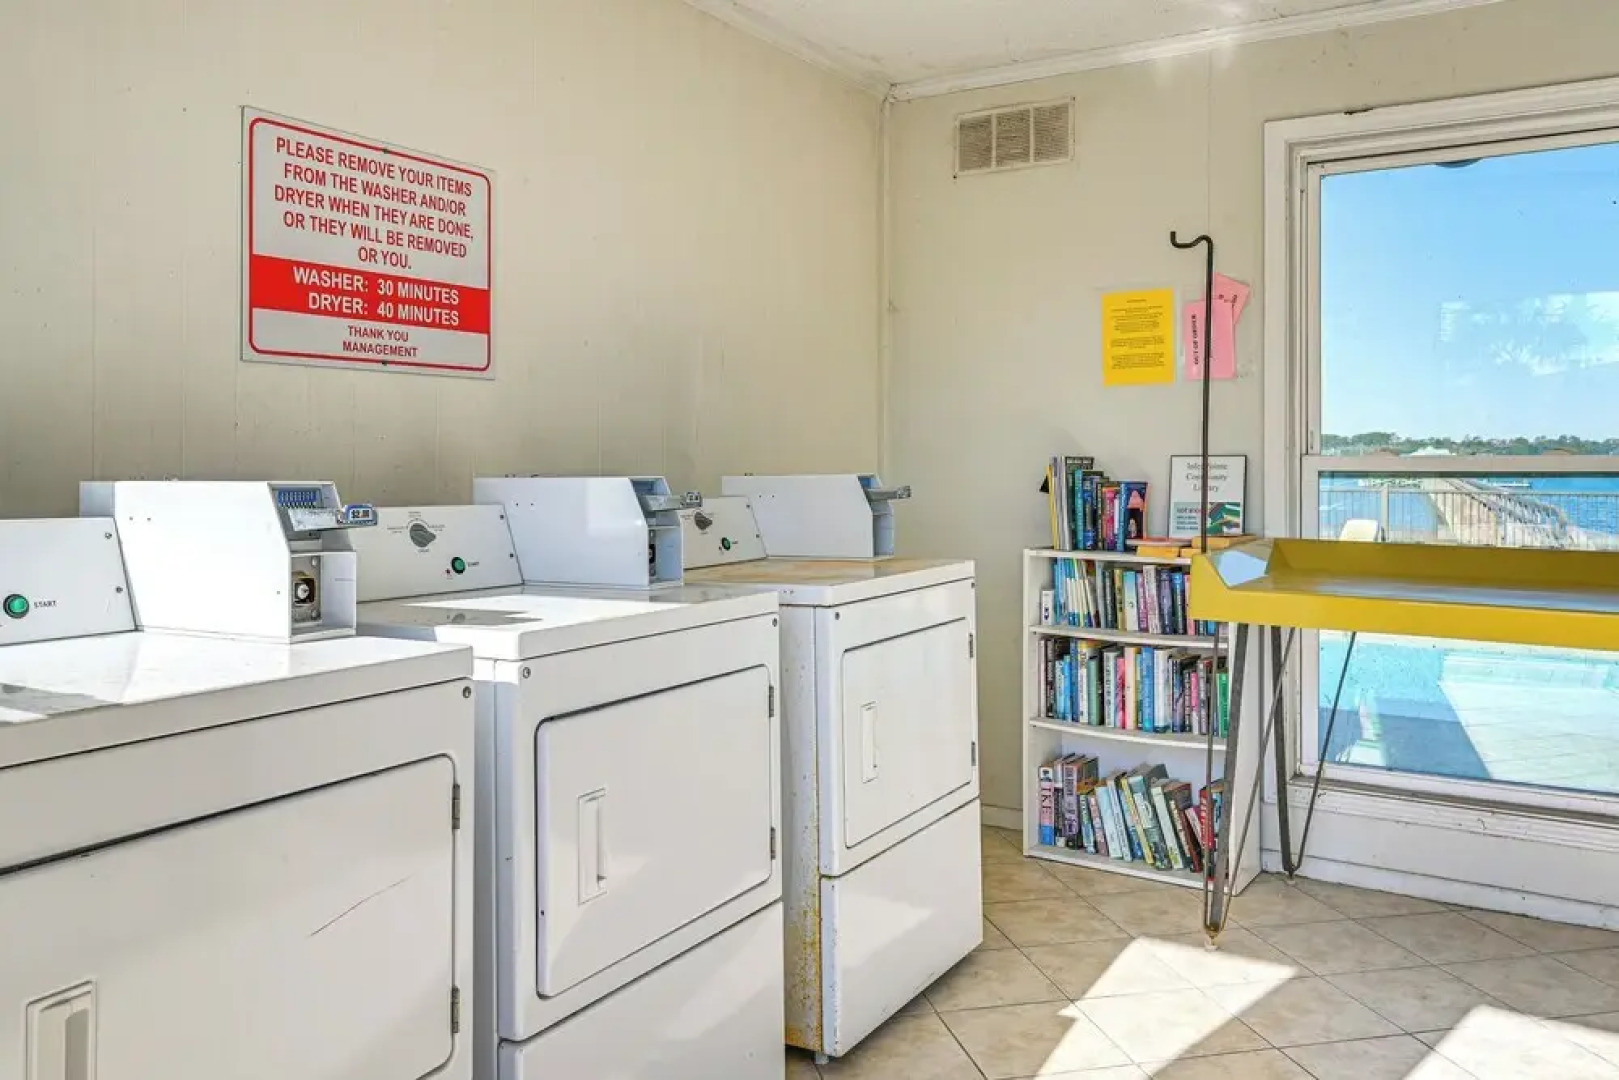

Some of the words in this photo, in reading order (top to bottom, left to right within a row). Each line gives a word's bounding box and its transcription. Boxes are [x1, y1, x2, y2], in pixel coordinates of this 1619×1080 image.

[276, 136, 334, 165] PLEASE
[338, 153, 395, 179] REMOVE
[398, 166, 433, 187] YOUR
[437, 176, 472, 197] ITEMS
[284, 163, 326, 187] FROM
[330, 172, 357, 193] THE
[361, 180, 417, 206] WASHER
[420, 194, 466, 216] AND/OR
[274, 184, 324, 209] DRYER
[328, 195, 369, 218] WHEN
[374, 204, 407, 225] THEY
[410, 214, 435, 231] ARE
[438, 218, 473, 240] DONE,
[283, 211, 305, 230] OR
[309, 215, 347, 236] THEY
[350, 223, 382, 243] WILL
[386, 230, 404, 246] BE
[407, 234, 467, 258] REMOVED
[358, 246, 378, 263] OR
[381, 250, 412, 269] YOU.
[293, 266, 369, 292] WASHER:
[377, 278, 393, 296] 30
[397, 282, 459, 305] MINUTES
[308, 292, 368, 315] DRYER:
[377, 302, 393, 318] 40
[397, 303, 459, 326] MINUTES
[342, 341, 418, 357] MANAGEMENT
[347, 325, 384, 340] THANK
[386, 330, 409, 343] YOU
[1186, 472, 1228, 481] Comunity
[1192, 483, 1219, 492] Liary
